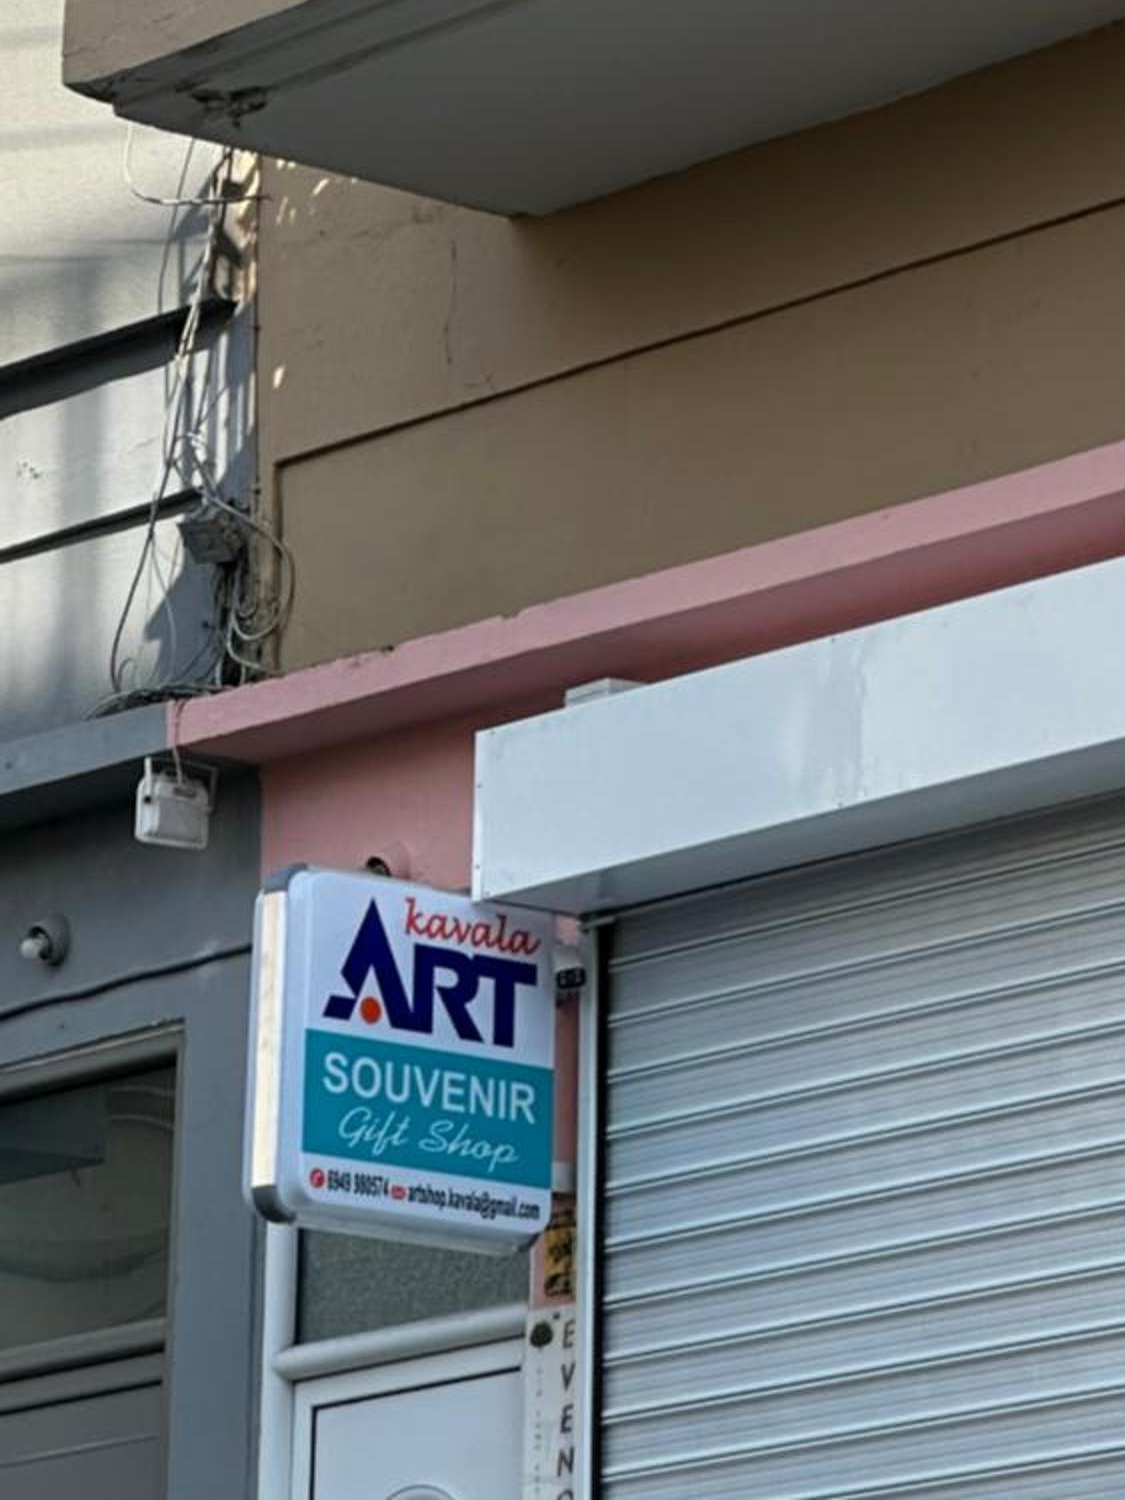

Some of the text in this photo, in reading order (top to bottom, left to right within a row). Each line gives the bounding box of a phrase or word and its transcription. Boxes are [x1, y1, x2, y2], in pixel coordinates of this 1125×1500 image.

[405, 897, 541, 956] kavala
[322, 898, 538, 1048] ART
[323, 1052, 536, 1125] SOUVENIR
[338, 1106, 520, 1172] Gift Shop
[408, 1184, 541, 1220] artshop.kavala@gmail.com
